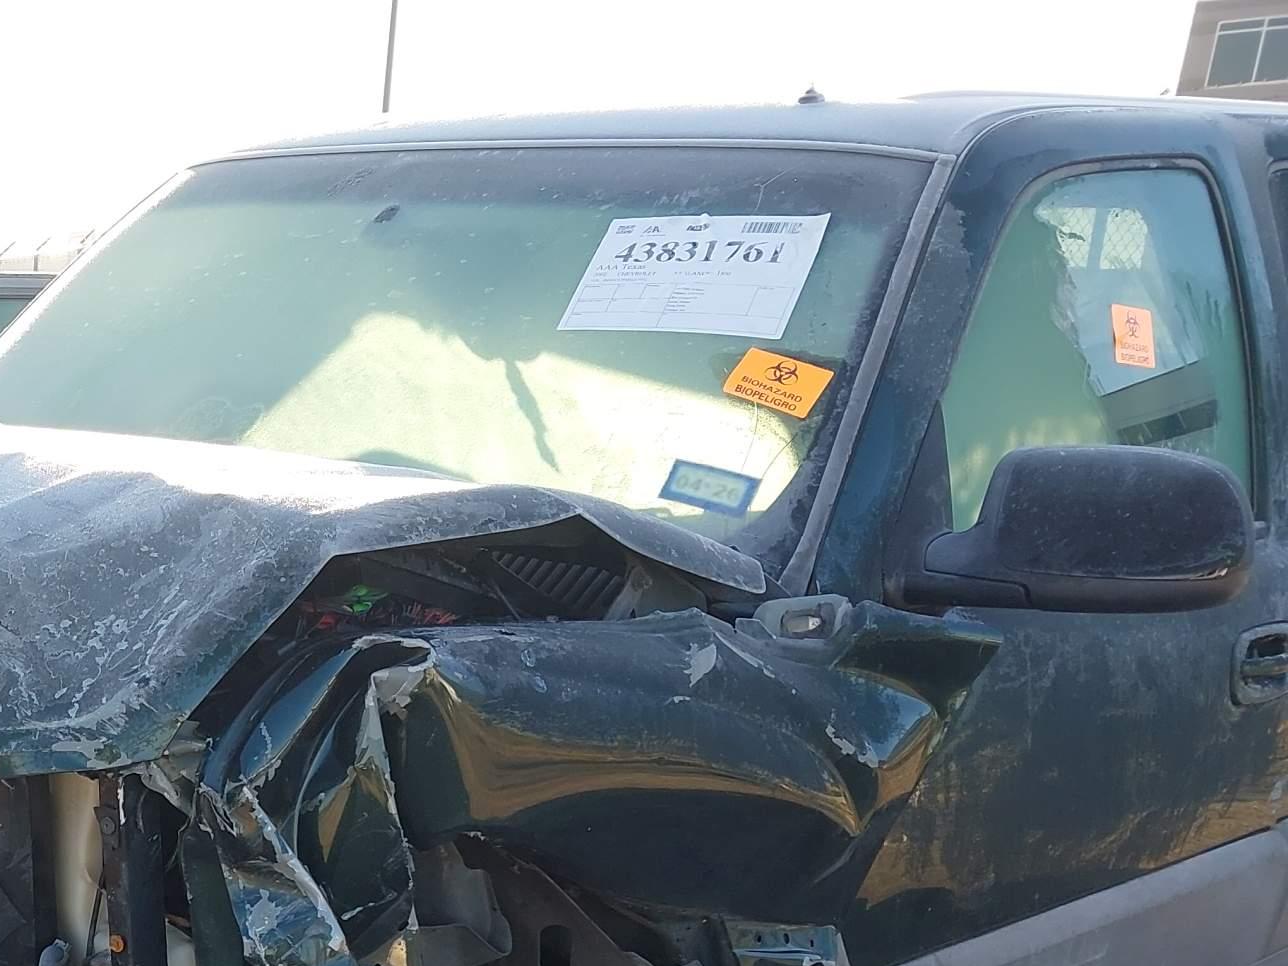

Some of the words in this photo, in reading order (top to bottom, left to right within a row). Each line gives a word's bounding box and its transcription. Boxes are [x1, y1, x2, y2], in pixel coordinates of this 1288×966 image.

[614, 240, 785, 263] 43831761
[734, 384, 797, 412] BIOPELIGRO
[741, 375, 803, 404] BIOHAZARD
